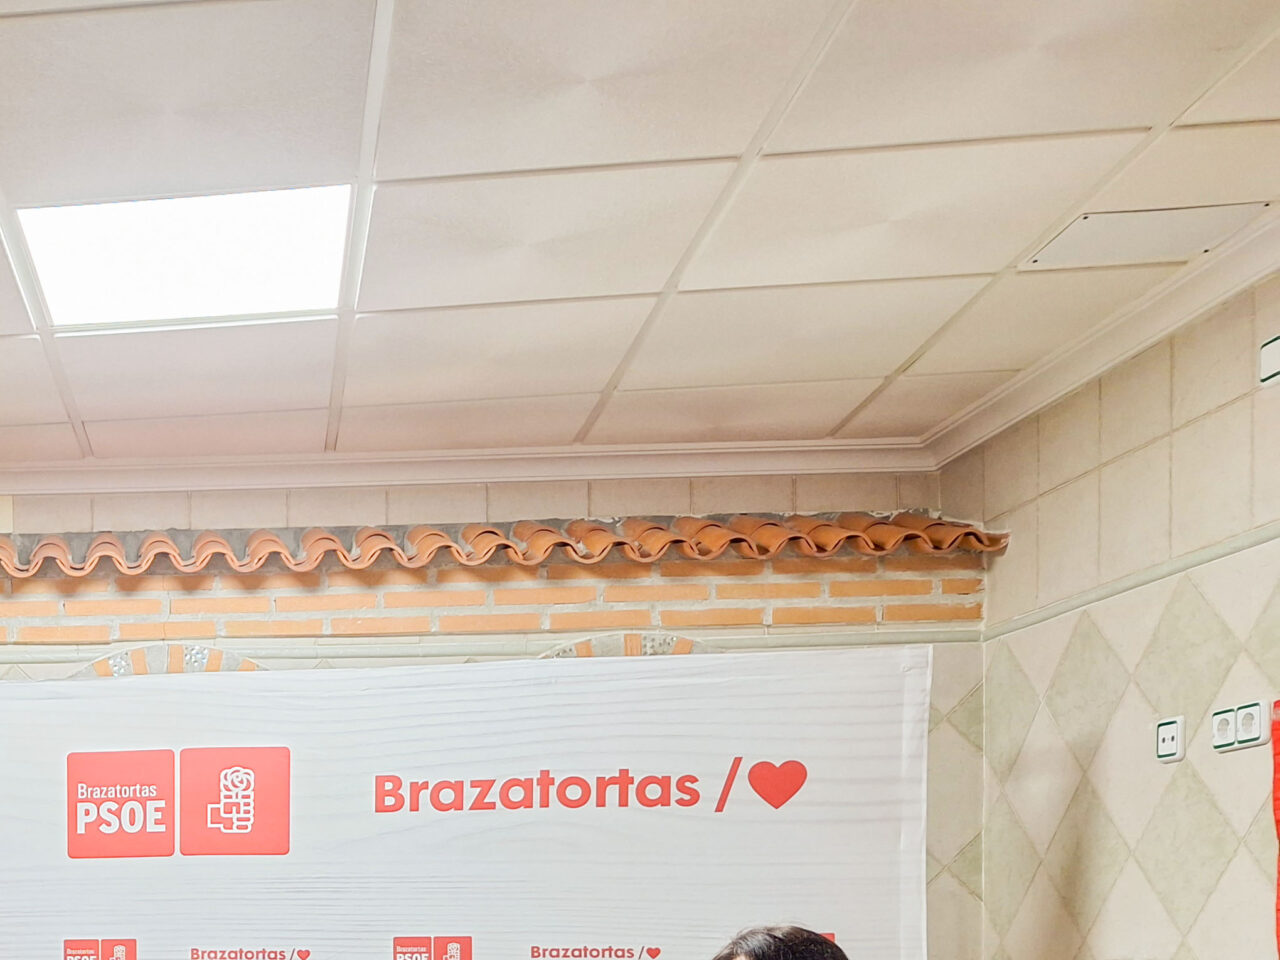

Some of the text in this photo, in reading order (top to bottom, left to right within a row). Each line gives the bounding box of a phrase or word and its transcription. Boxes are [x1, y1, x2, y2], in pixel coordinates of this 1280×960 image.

[77, 782, 157, 799] Brazatortas
[375, 769, 701, 813] Brazatortas
[76, 800, 166, 834] PSOE
[190, 948, 287, 960] Brazatortas
[530, 945, 635, 959] Brazatortas
